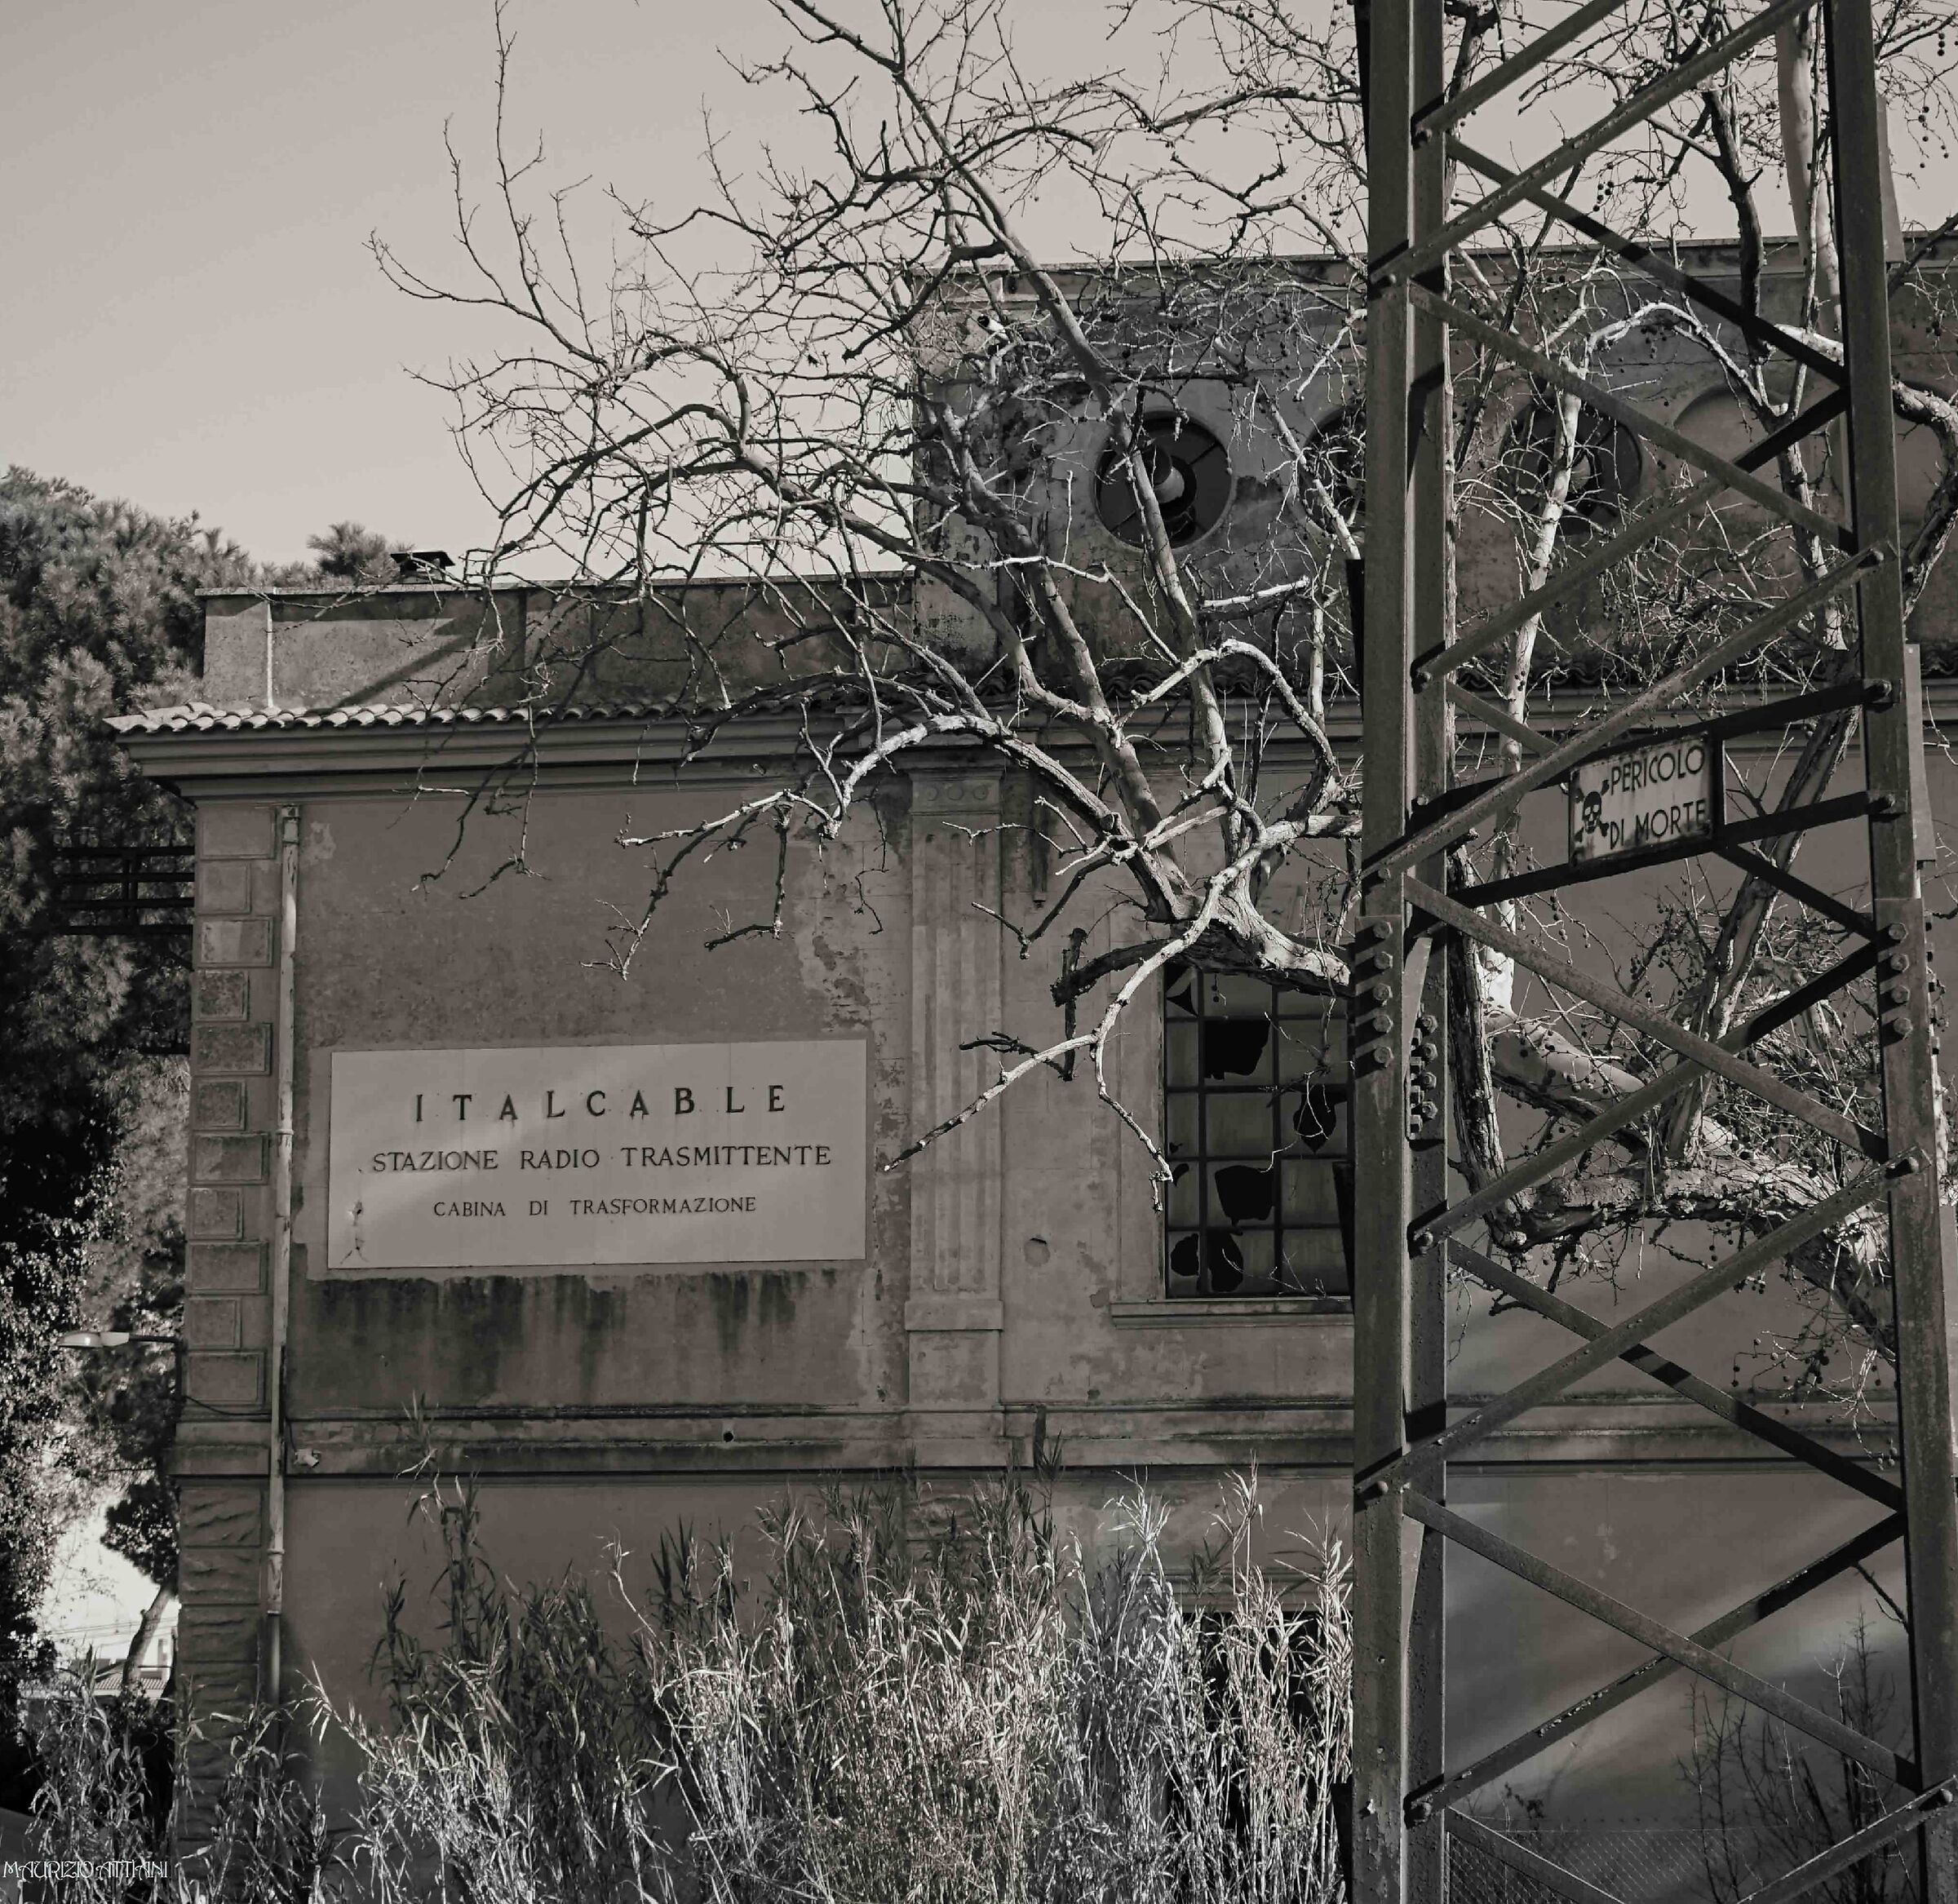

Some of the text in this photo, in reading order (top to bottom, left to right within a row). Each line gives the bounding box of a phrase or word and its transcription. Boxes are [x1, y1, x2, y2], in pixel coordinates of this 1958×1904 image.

[1610, 746, 1705, 795] PERICOLO
[1610, 799, 1707, 850] DI MORTE
[414, 1085, 786, 1122] ITALCABLE
[372, 1145, 832, 1172] STAZIONE RADIO TRASMITTENTE
[433, 1196, 757, 1217] CABINA DI TRASFORMAZIONE
